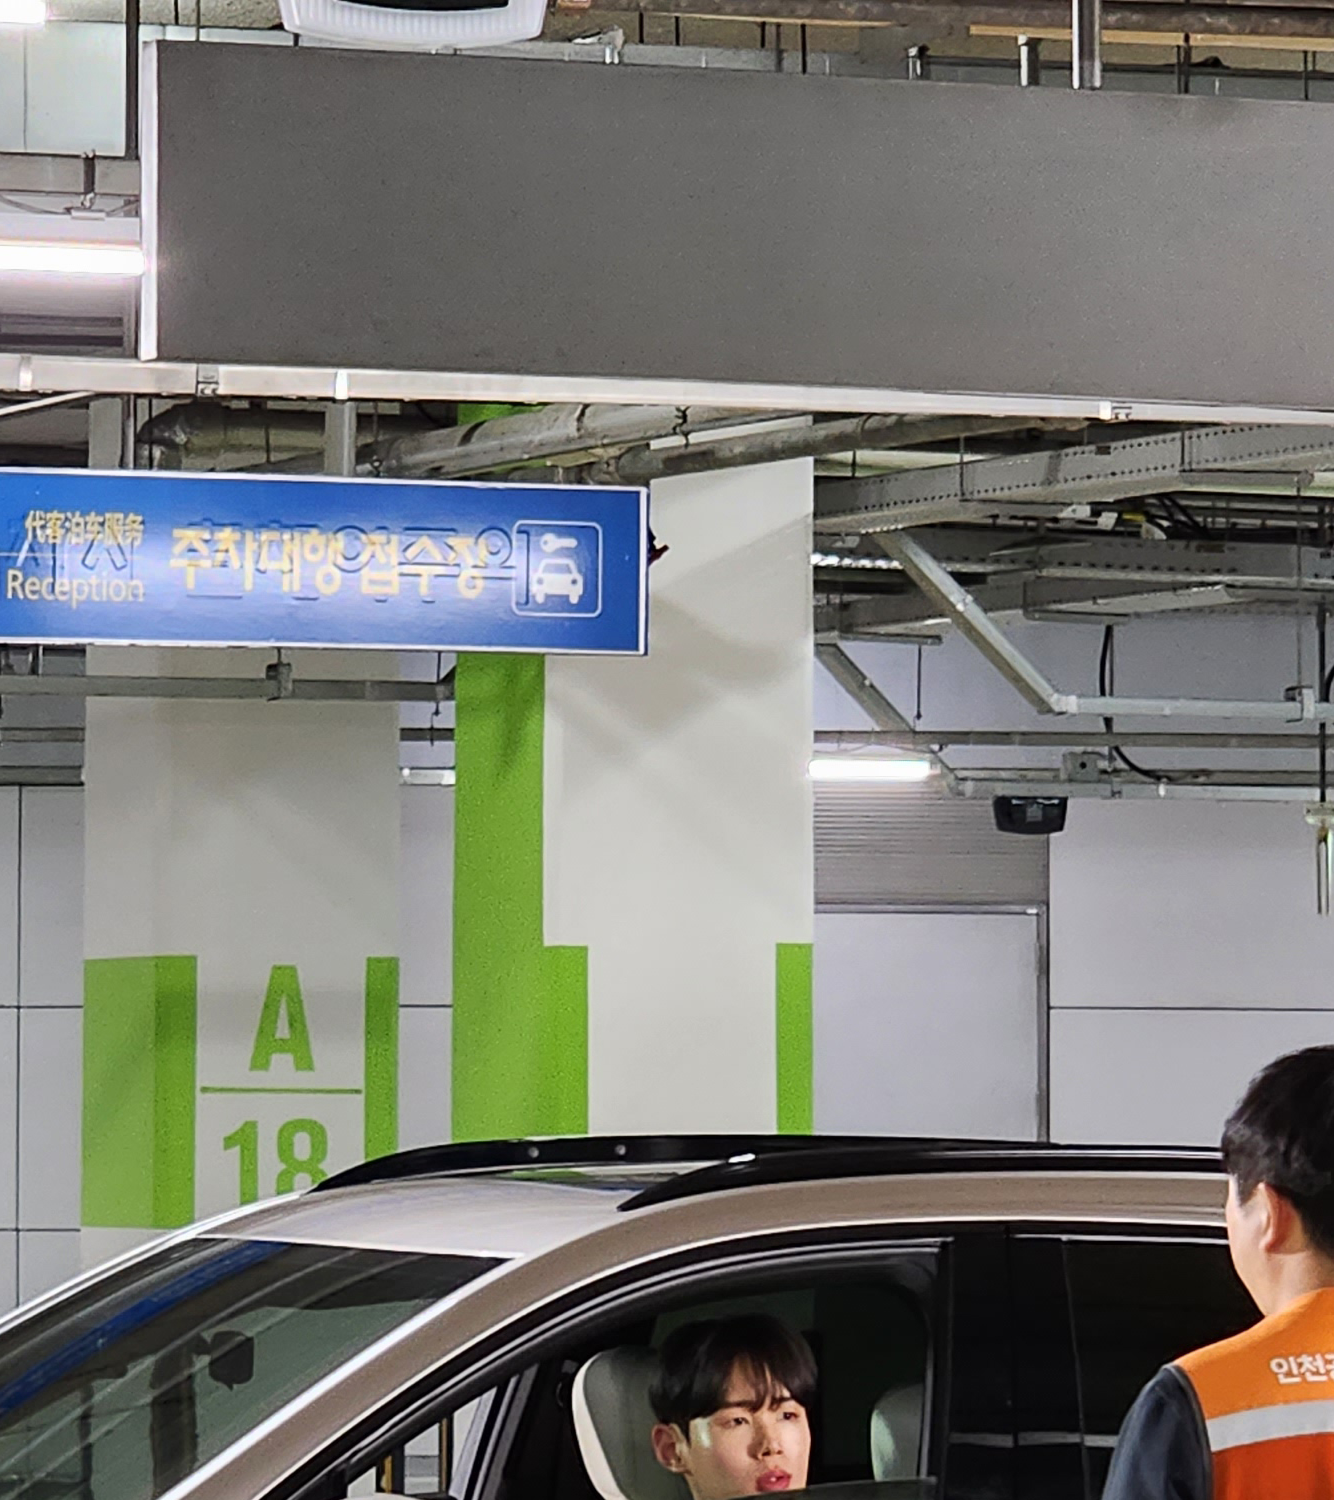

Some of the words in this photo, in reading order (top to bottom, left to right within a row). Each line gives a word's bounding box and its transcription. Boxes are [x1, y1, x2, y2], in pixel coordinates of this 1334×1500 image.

[25, 510, 145, 547] 代客泊车服务
[170, 526, 343, 596] 주차대행
[359, 529, 490, 600] 접수장
[7, 568, 145, 608] Reception
[248, 964, 315, 1072] A
[223, 1117, 328, 1206] 18
